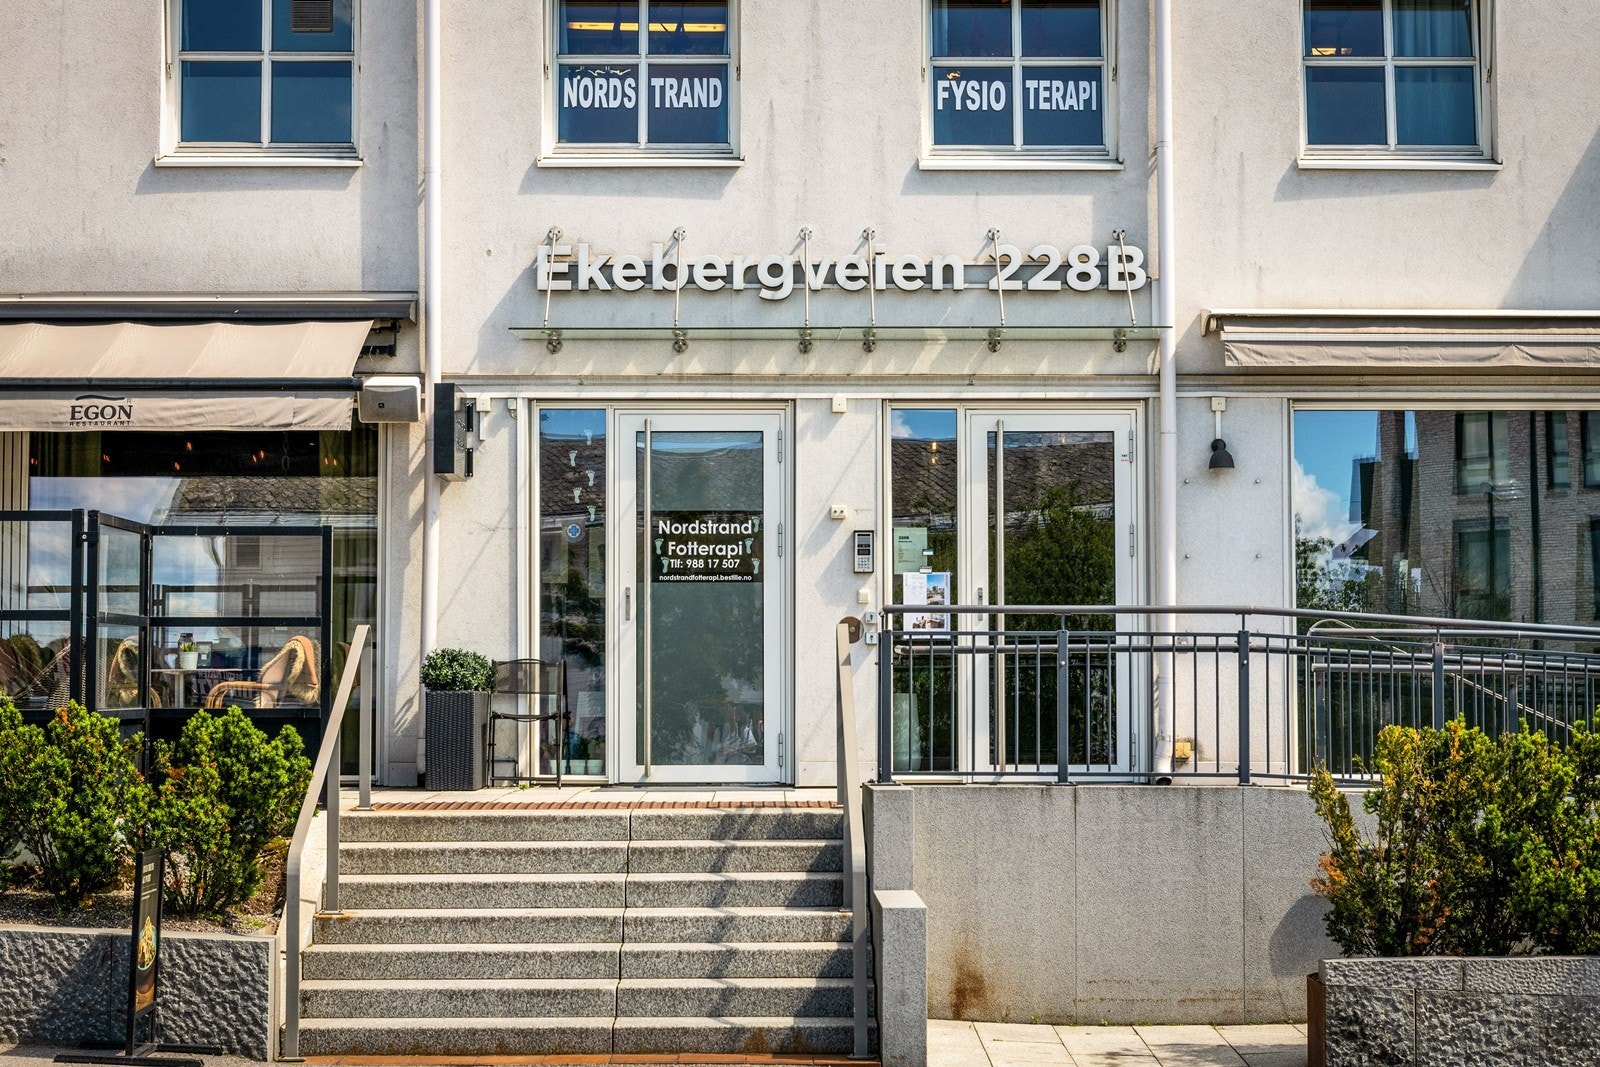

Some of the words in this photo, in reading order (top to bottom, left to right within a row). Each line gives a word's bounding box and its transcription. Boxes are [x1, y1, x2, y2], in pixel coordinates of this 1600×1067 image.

[563, 77, 636, 109] NORDS
[651, 77, 722, 108] TRAND
[937, 80, 1006, 111] FYSIO
[1026, 80, 1097, 111] TERAPI
[537, 243, 965, 300] Ekebergveien
[988, 244, 1148, 291] 228B
[70, 405, 133, 420] EGON
[658, 520, 752, 534] Nordstrand
[668, 541, 743, 558] Fotterapi
[670, 559, 683, 568] Tlf:
[686, 559, 704, 568] 988
[708, 559, 719, 568] 17
[722, 559, 740, 568] 507
